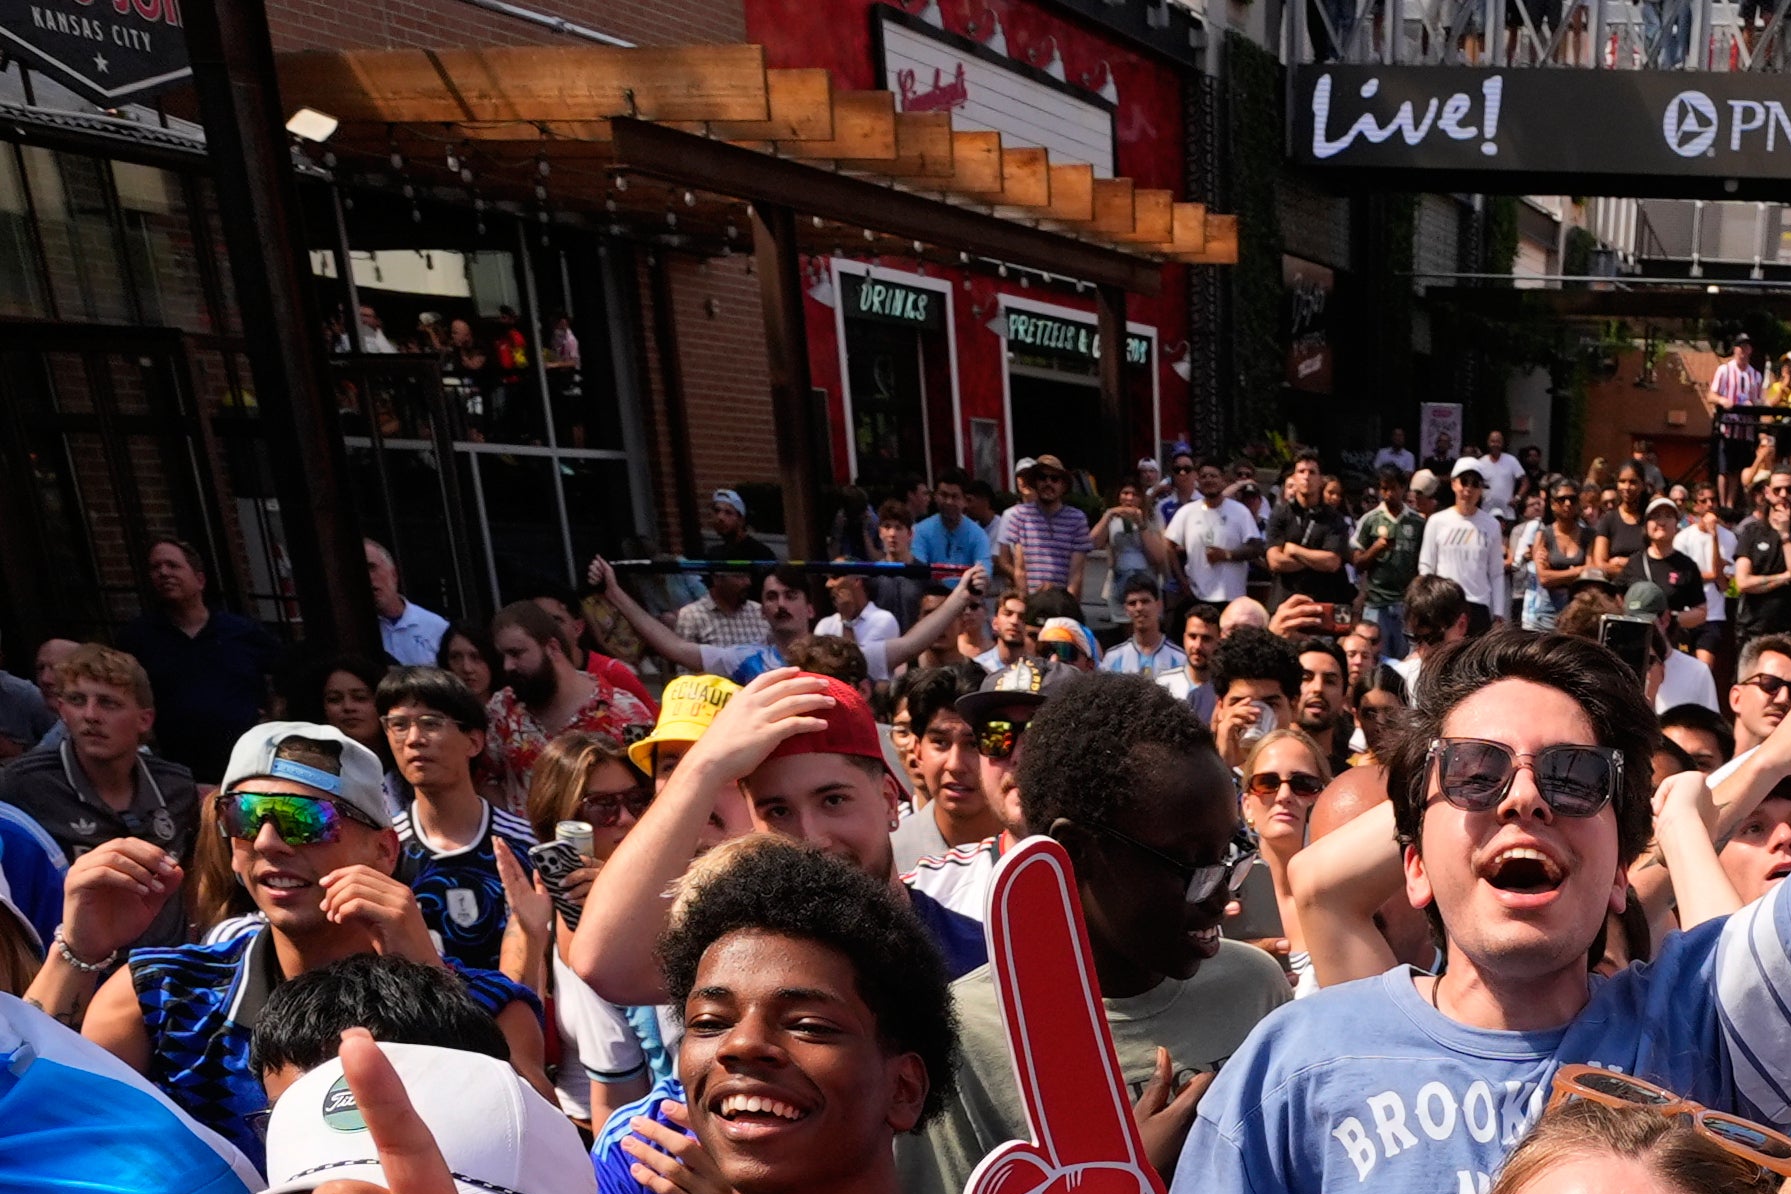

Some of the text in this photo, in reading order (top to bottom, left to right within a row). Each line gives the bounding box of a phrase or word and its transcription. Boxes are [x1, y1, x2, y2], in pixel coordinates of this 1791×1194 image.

[31, 5, 104, 42] KANSAS
[111, 25, 151, 53] CITY
[1312, 73, 1502, 158] Live!
[860, 283, 928, 321] DRINKS
[1009, 313, 1076, 350] PRETZELS
[1332, 1080, 1545, 1182] BROOK
